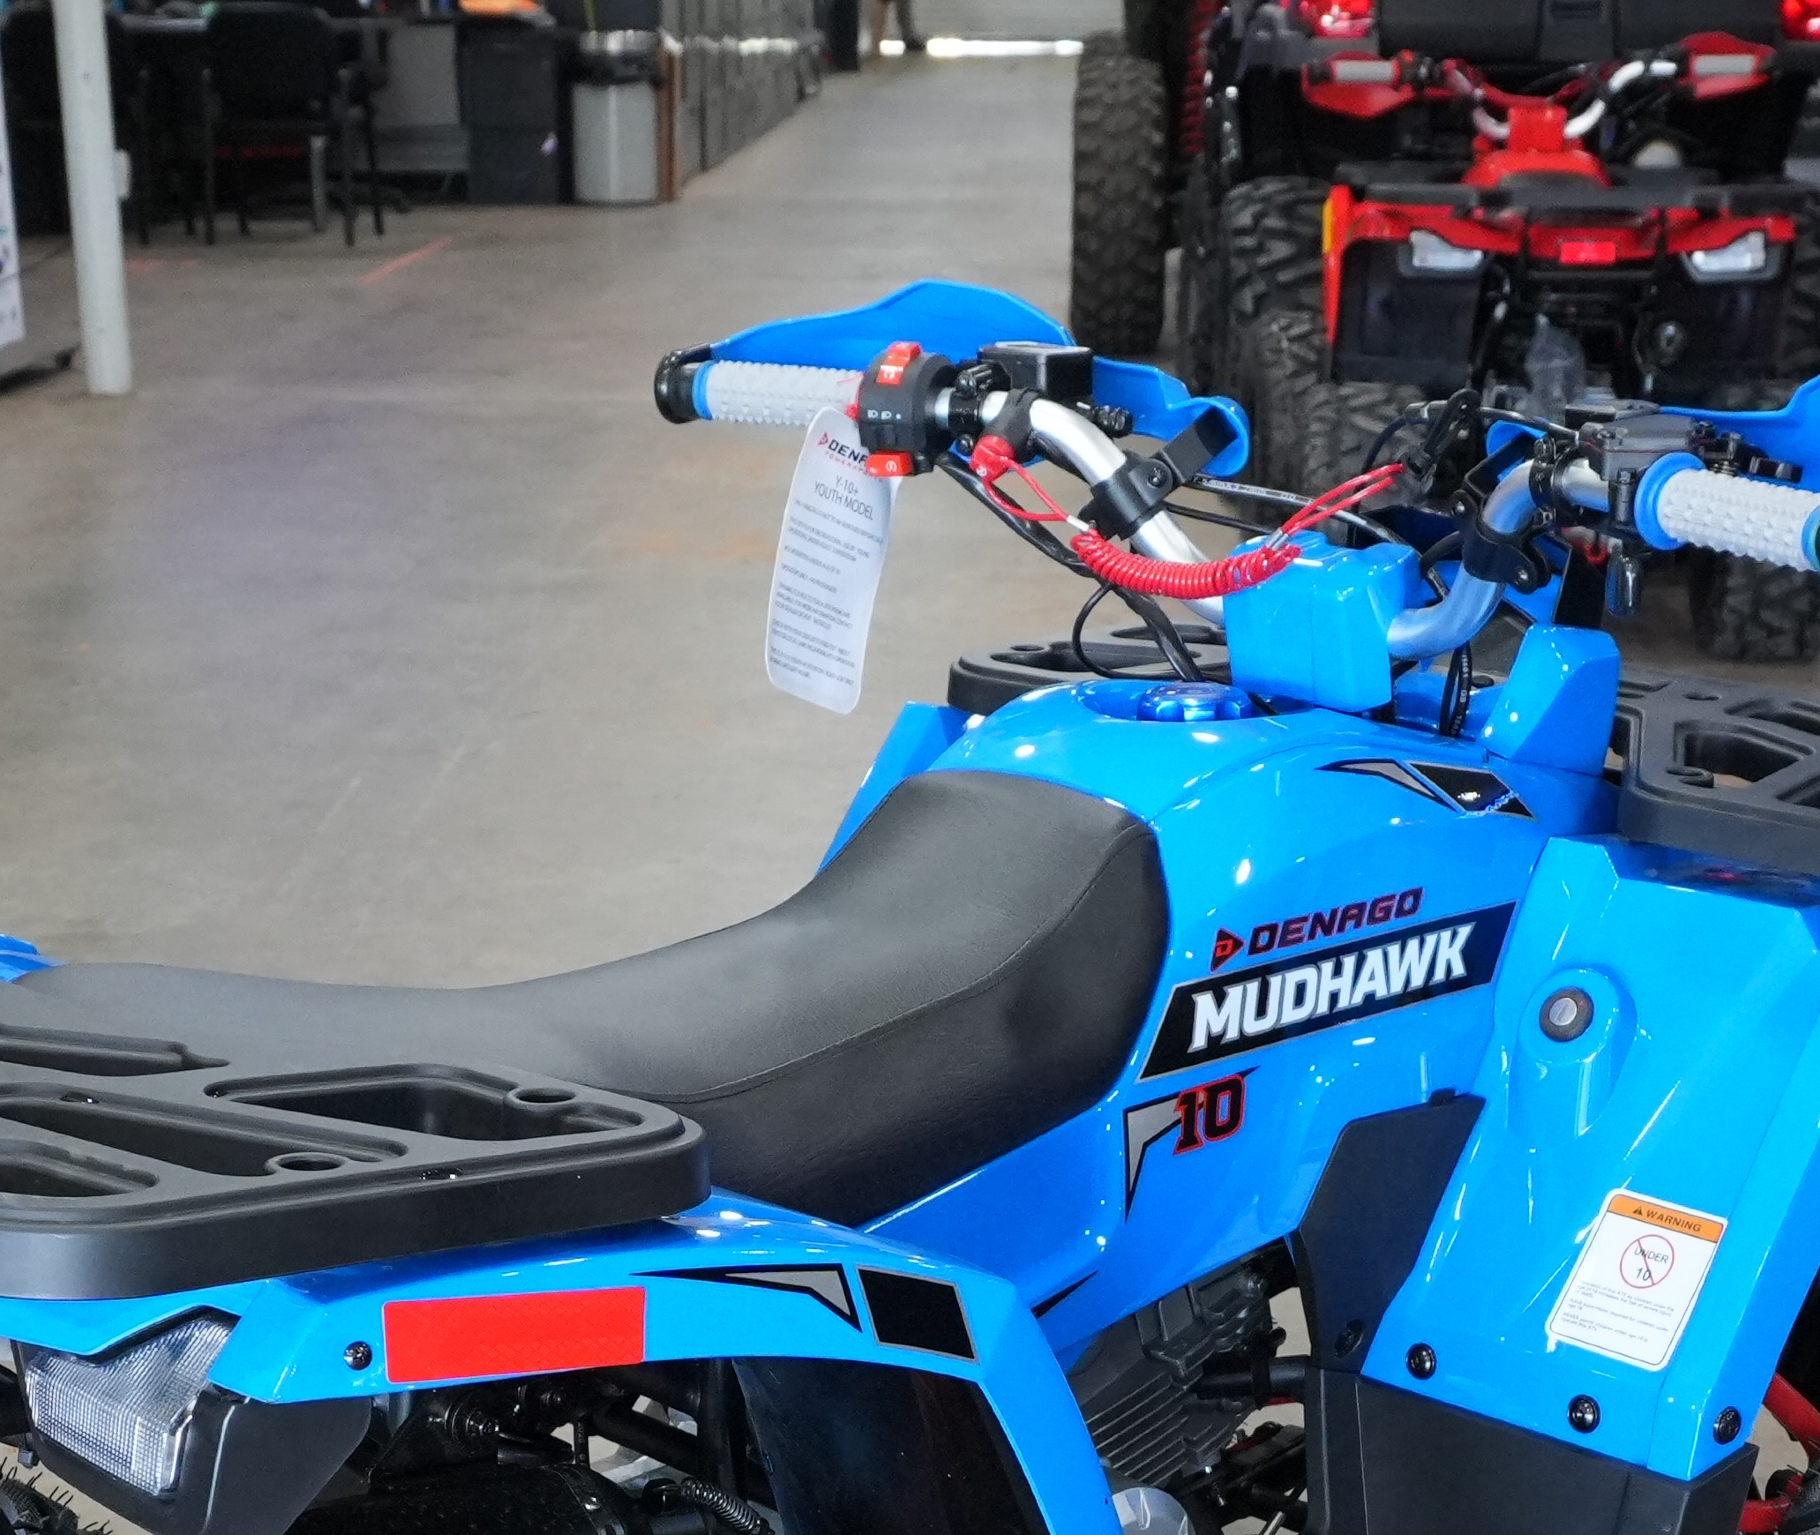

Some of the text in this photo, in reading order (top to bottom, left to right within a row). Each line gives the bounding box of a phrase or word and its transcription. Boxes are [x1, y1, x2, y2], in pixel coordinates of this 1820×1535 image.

[828, 439, 869, 464] DENA
[835, 474, 859, 496] Y-10+
[814, 481, 874, 521] YOUTH MODEL
[1247, 886, 1425, 957] DENAGO
[1187, 921, 1476, 1054] MUDHAWK
[1173, 1073, 1247, 1156] 10
[1646, 1209, 1702, 1233] WARNING
[1634, 1246, 1669, 1264] UNDER
[1635, 1267, 1652, 1282] 10
